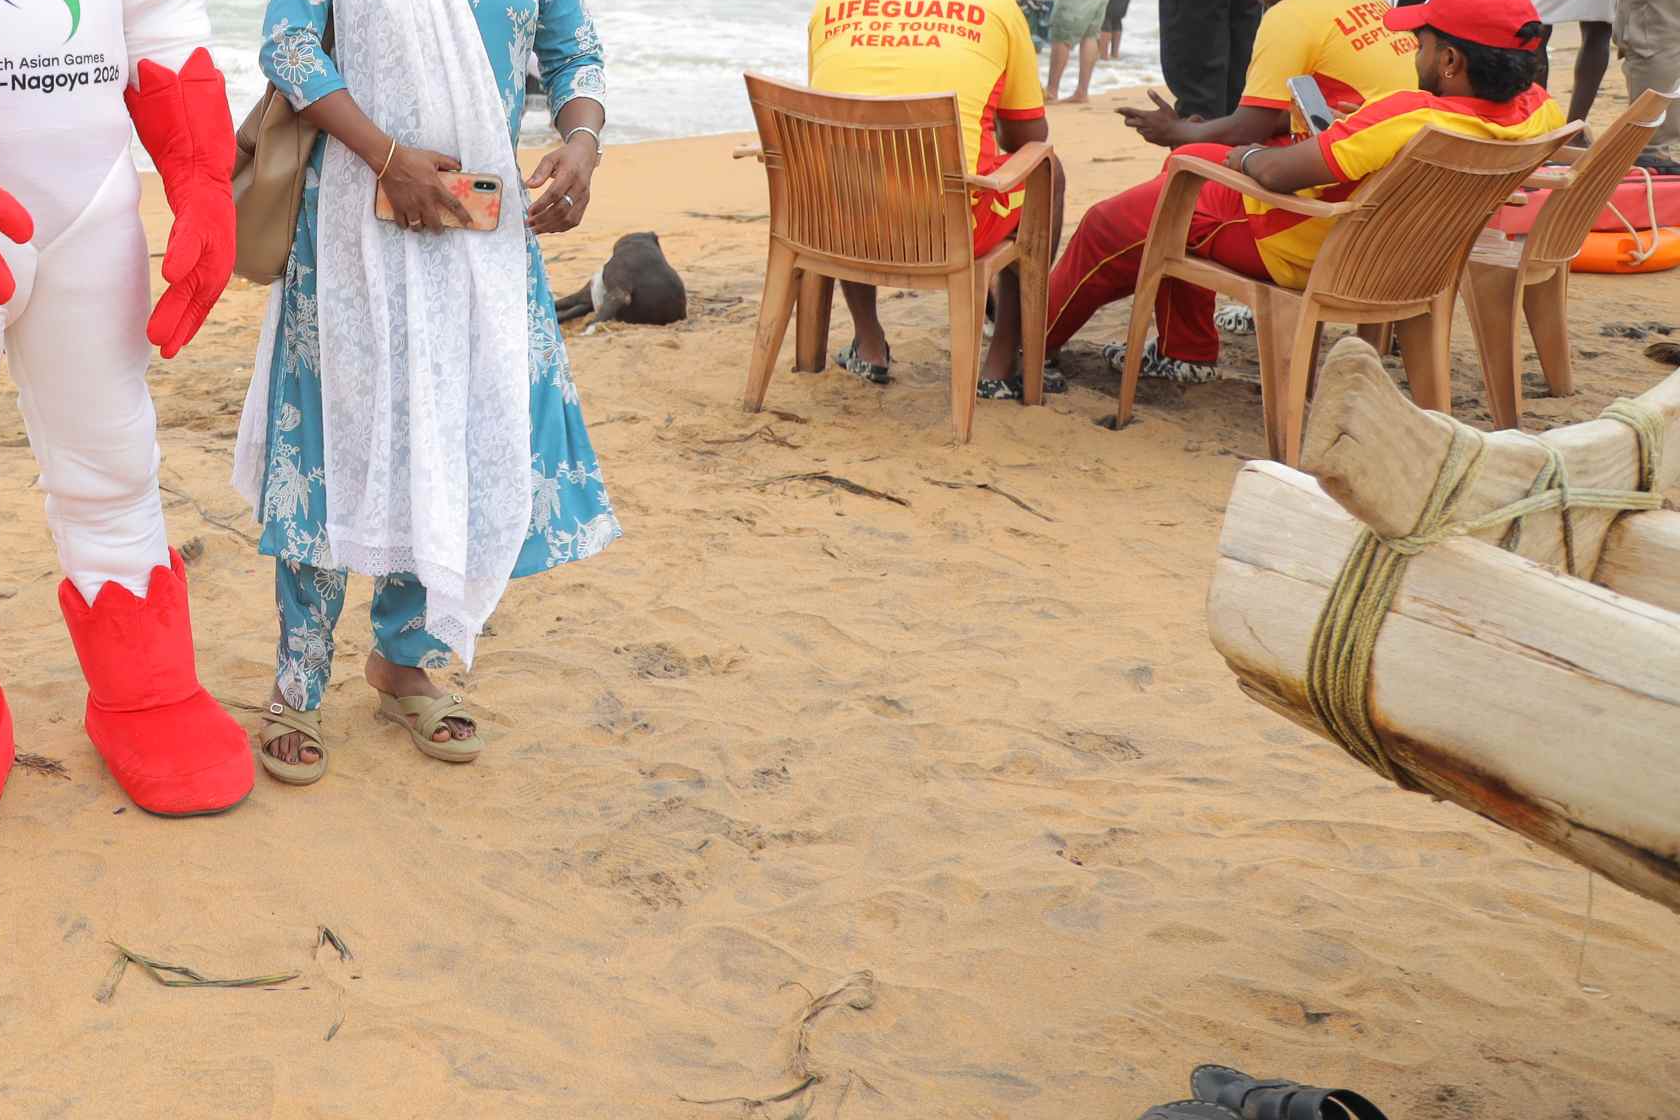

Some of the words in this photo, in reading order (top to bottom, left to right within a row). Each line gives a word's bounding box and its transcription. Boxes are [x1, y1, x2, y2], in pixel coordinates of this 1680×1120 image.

[824, 0, 986, 26] LIFEGUARD
[824, 21, 864, 40] DEPT.
[869, 20, 894, 32] OF
[897, 22, 982, 43] TOURISM
[850, 34, 942, 48] KERALA
[19, 55, 60, 70] Asian
[64, 53, 105, 66] Games
[93, 65, 120, 84] 2026
